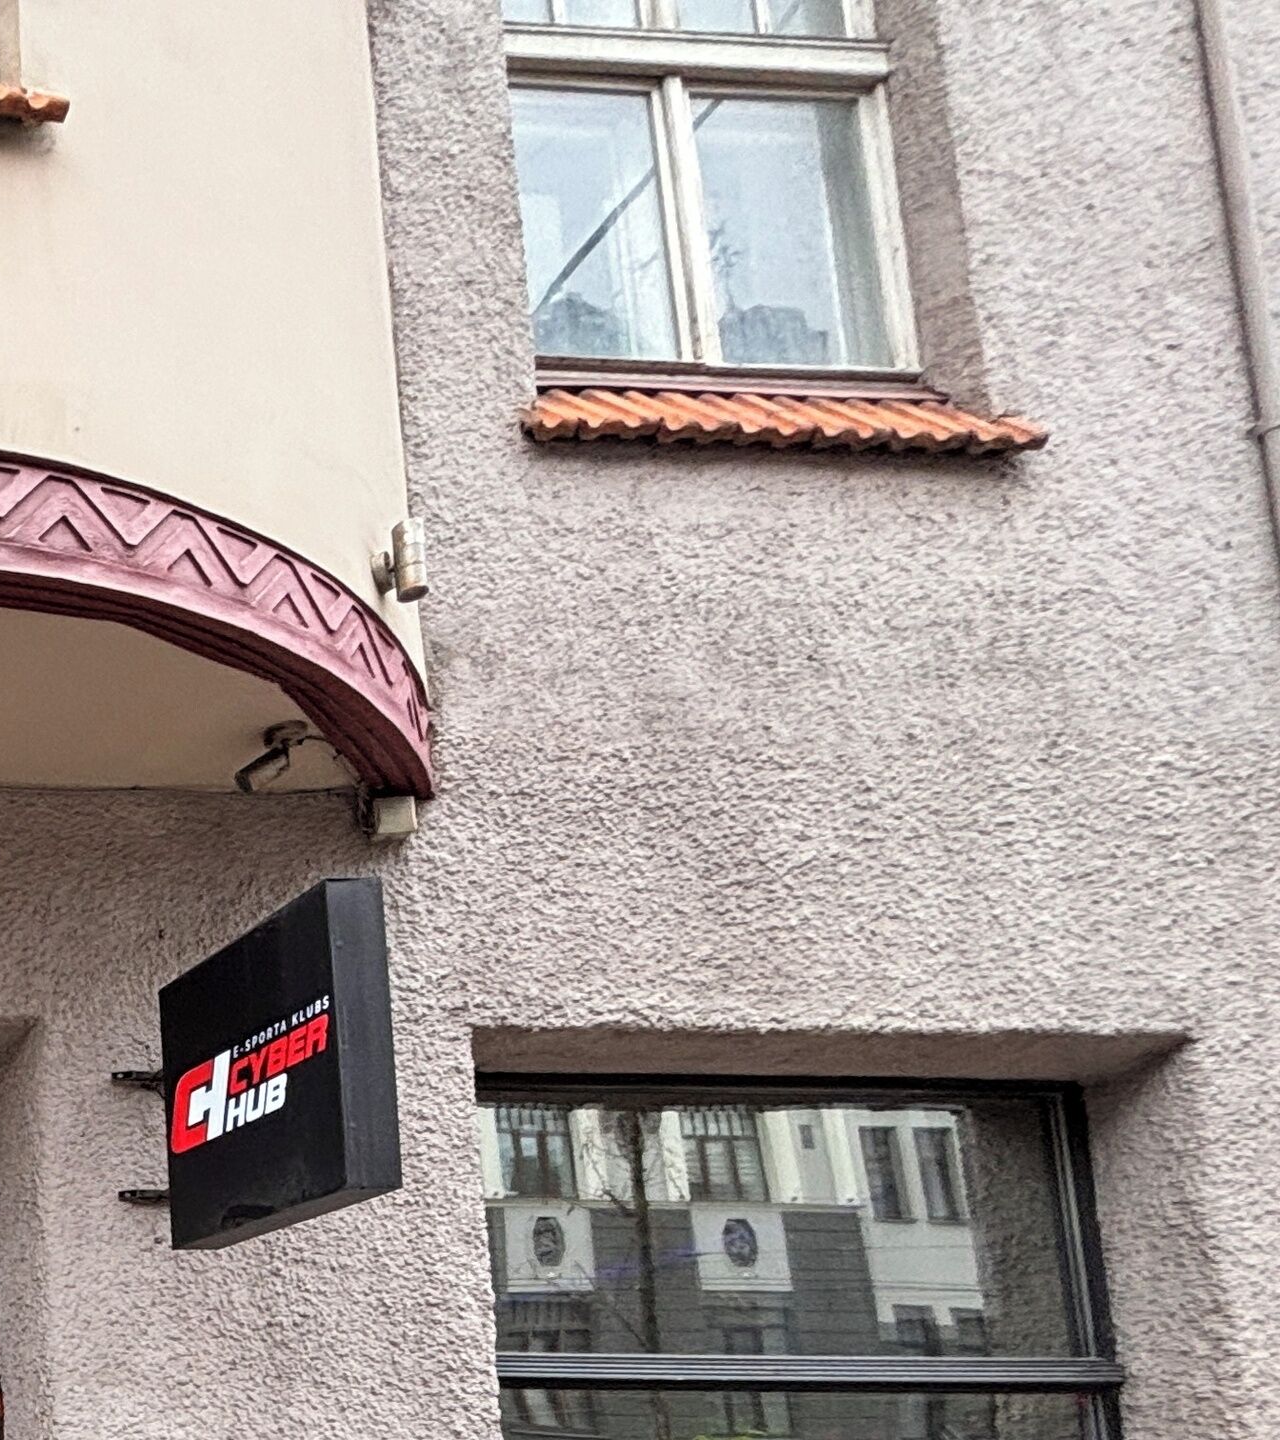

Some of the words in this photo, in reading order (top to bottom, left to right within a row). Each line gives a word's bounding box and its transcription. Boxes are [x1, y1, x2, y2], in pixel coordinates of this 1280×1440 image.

[229, 1013, 329, 1096] CYBER
[233, 1021, 287, 1059] E-SPORTA
[292, 995, 330, 1027] KLUBS
[225, 1072, 288, 1133] HUB
